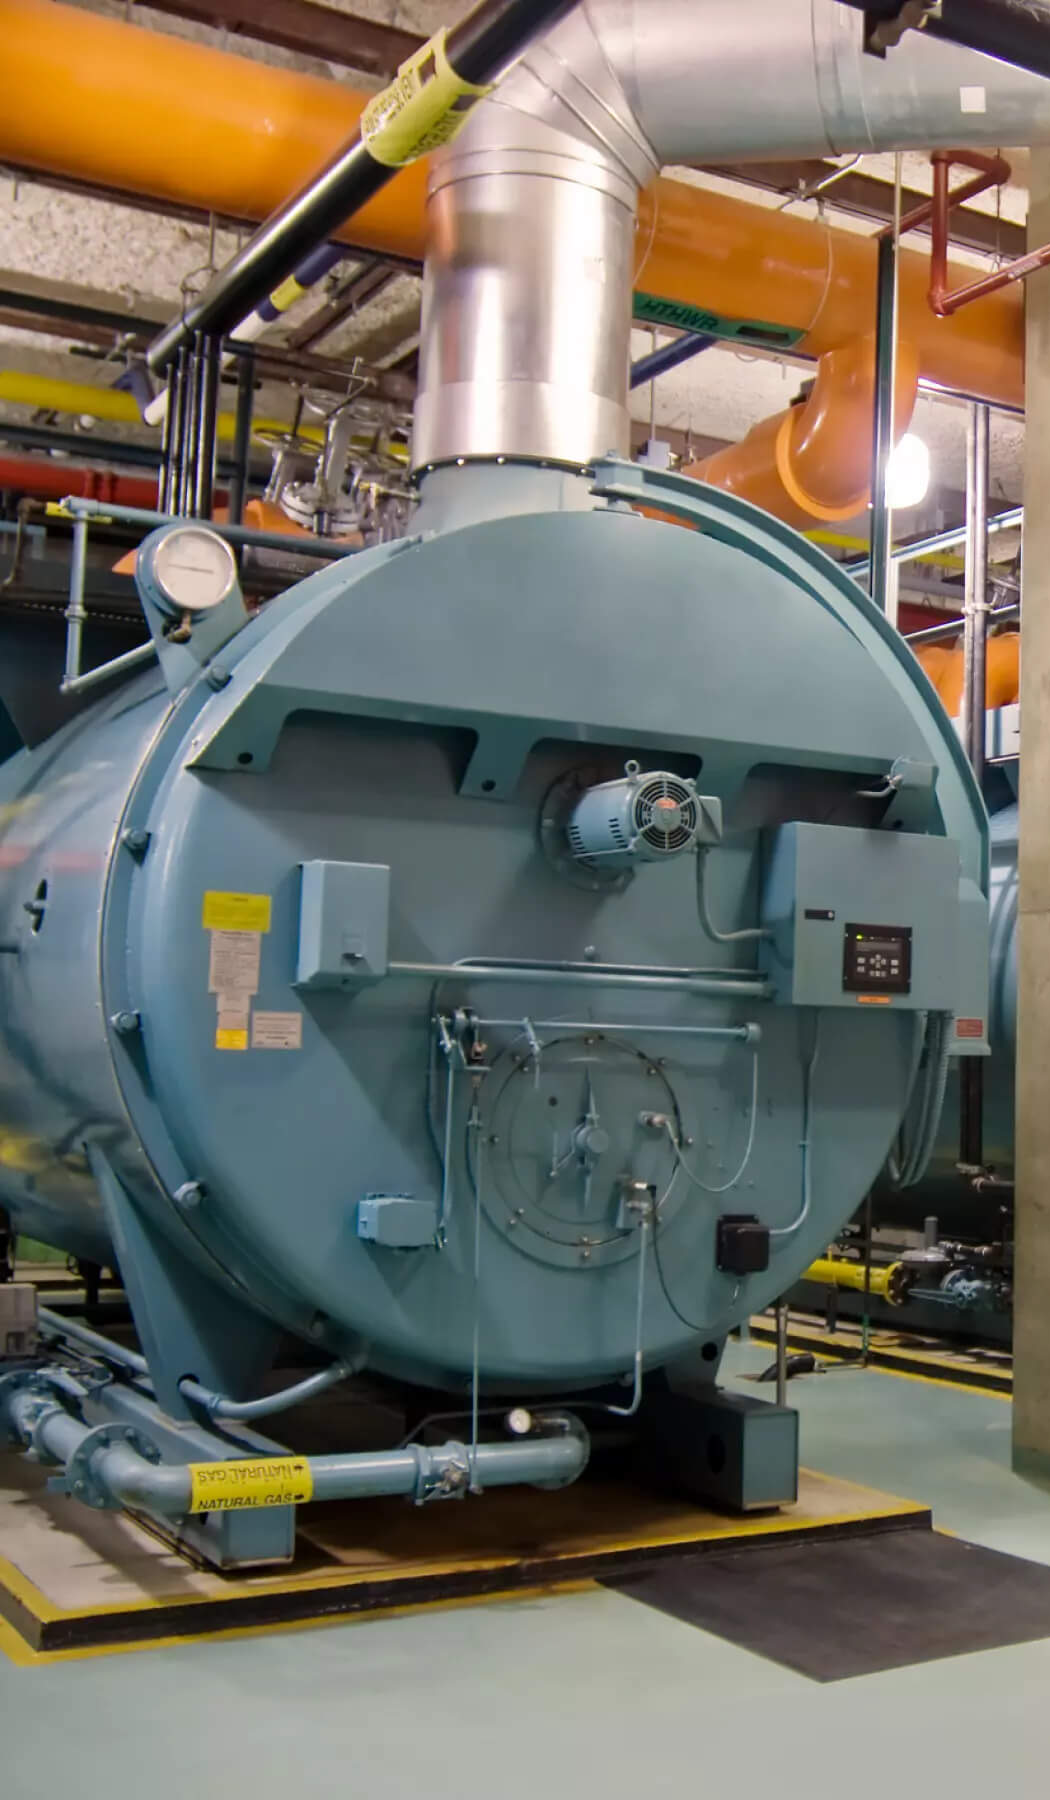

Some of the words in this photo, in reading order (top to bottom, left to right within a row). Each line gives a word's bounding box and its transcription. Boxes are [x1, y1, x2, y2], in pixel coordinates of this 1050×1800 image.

[197, 1470, 226, 1482] GAS
[228, 1464, 292, 1481] NATURAL
[197, 1496, 259, 1510] NATURAL
[265, 1493, 293, 1505] GAS
